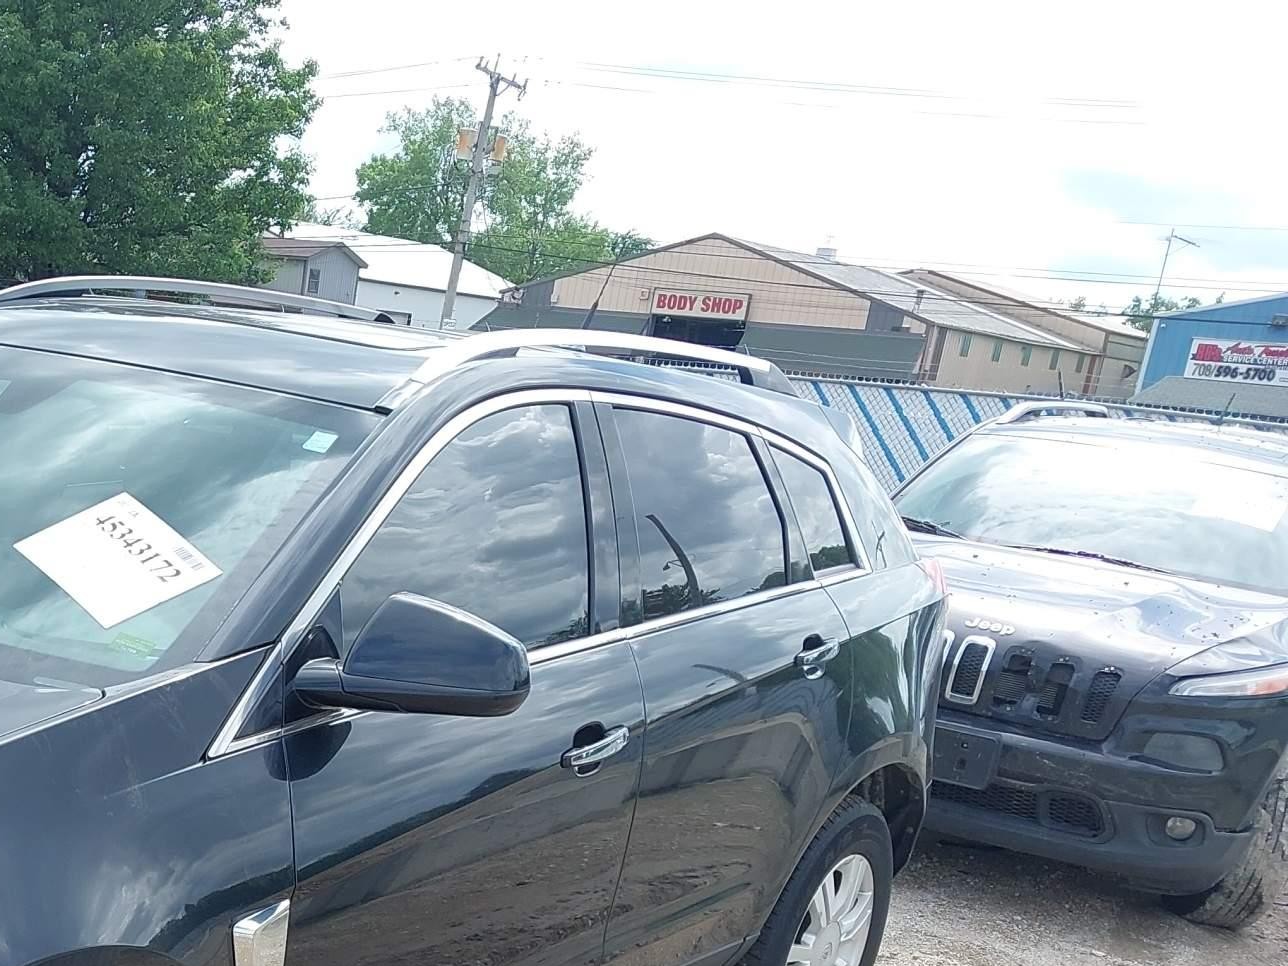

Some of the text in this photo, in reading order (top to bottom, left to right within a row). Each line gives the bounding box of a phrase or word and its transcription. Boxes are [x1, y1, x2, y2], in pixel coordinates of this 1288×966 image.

[656, 293, 744, 314] BODY SHOP
[1223, 354, 1256, 364] SERVICE
[1192, 362, 1276, 382] 708/596-5700
[95, 514, 182, 583] 45343172
[964, 617, 1016, 636] Jeep
